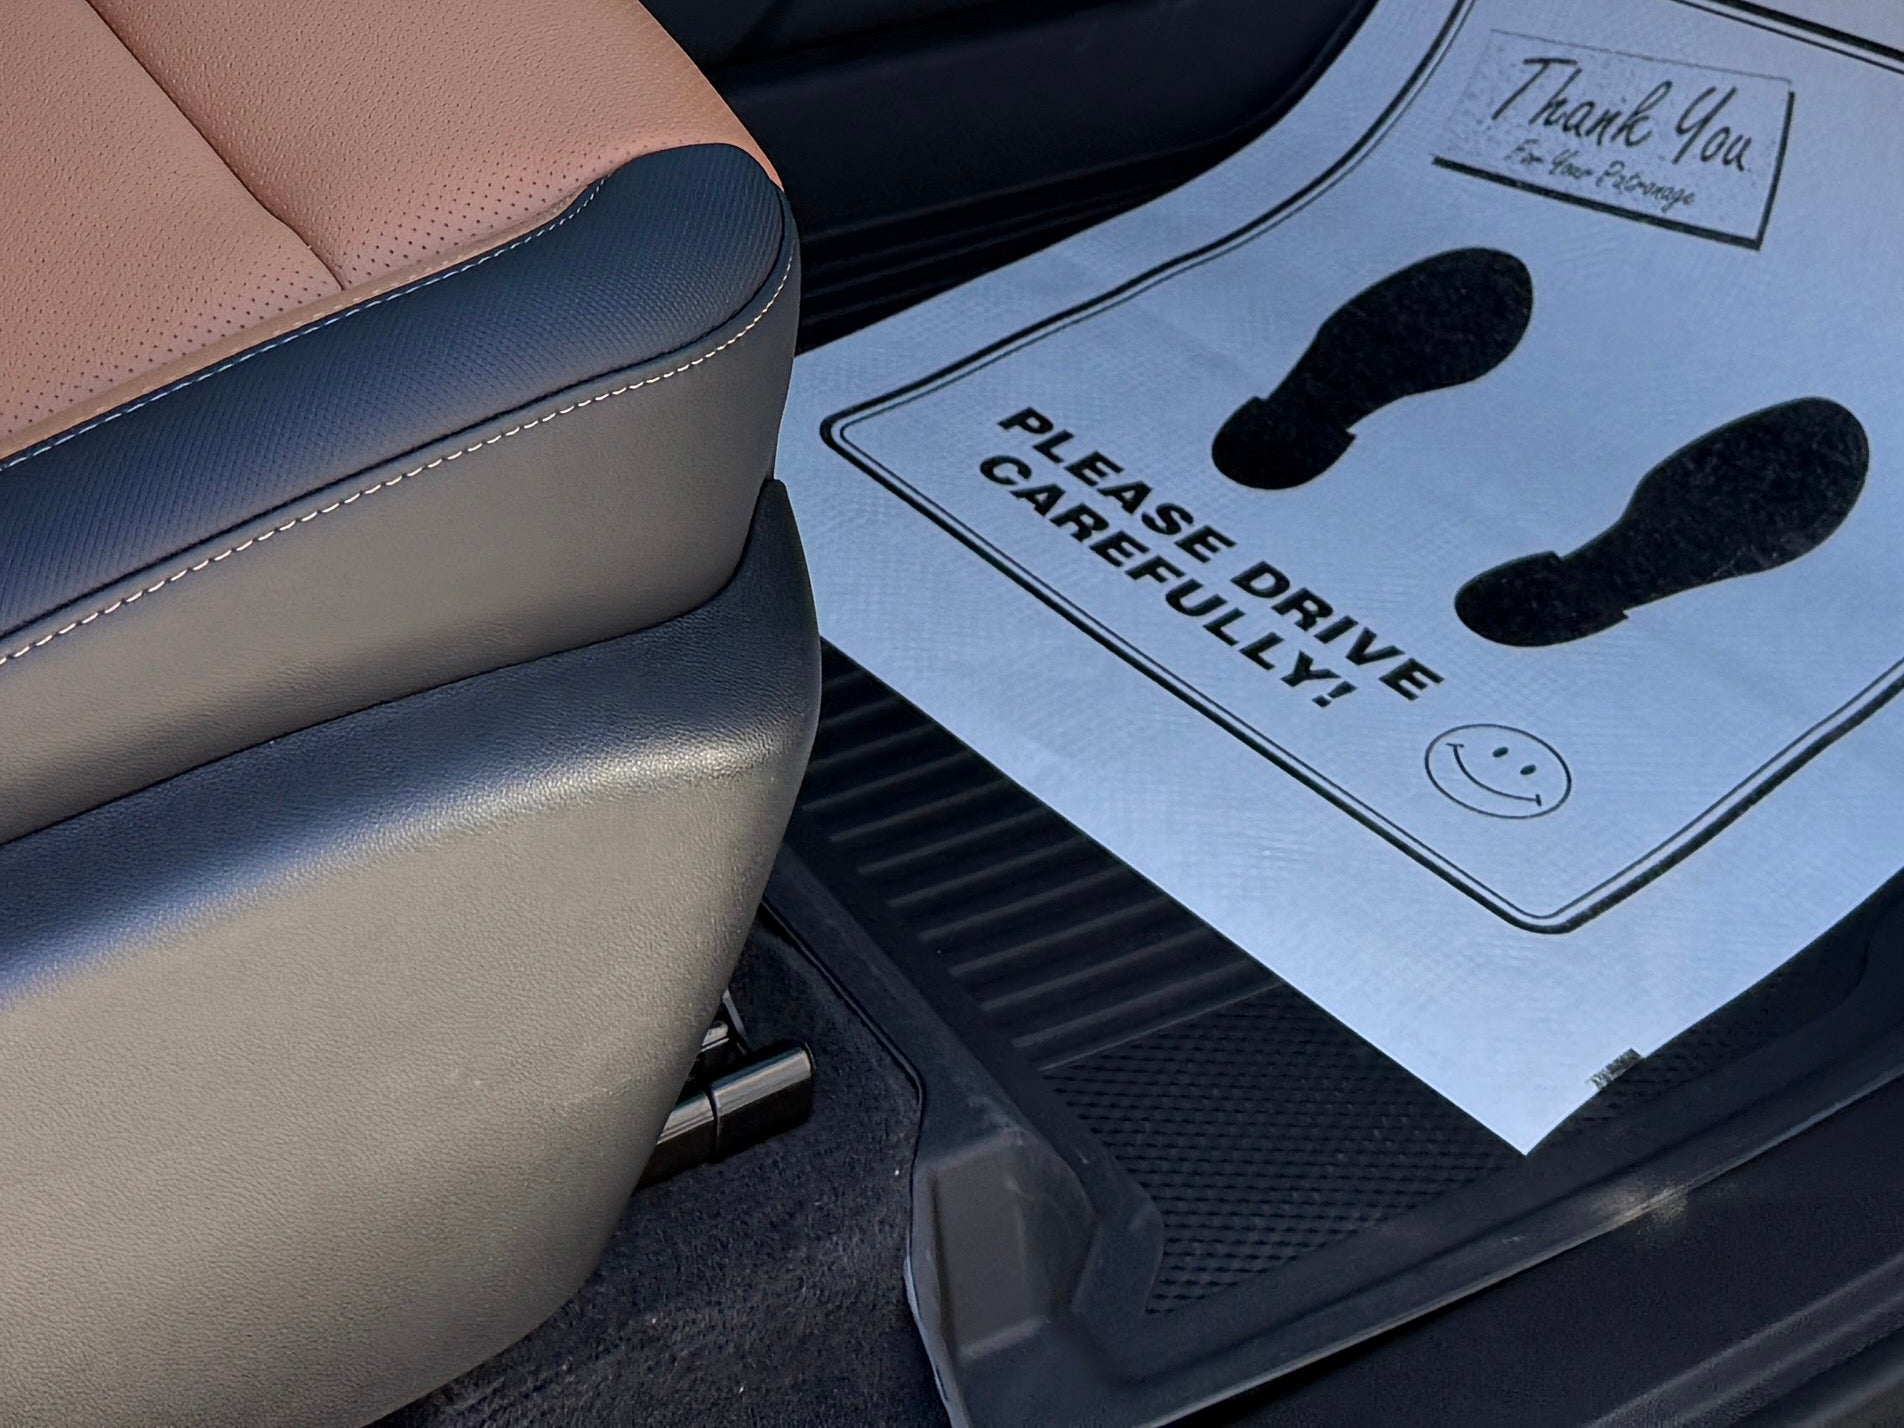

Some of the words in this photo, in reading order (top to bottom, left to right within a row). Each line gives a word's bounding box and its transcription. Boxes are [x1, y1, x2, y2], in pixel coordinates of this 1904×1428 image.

[1490, 56, 1675, 149] Thank
[1672, 85, 1754, 173] You
[1504, 139, 1544, 167] For
[1548, 148, 1593, 179] Your
[1596, 160, 1698, 213] Patronage
[979, 454, 1358, 709] CAREFULLY!
[998, 406, 1237, 564] PLEASE
[1231, 560, 1445, 702] DRIVE
